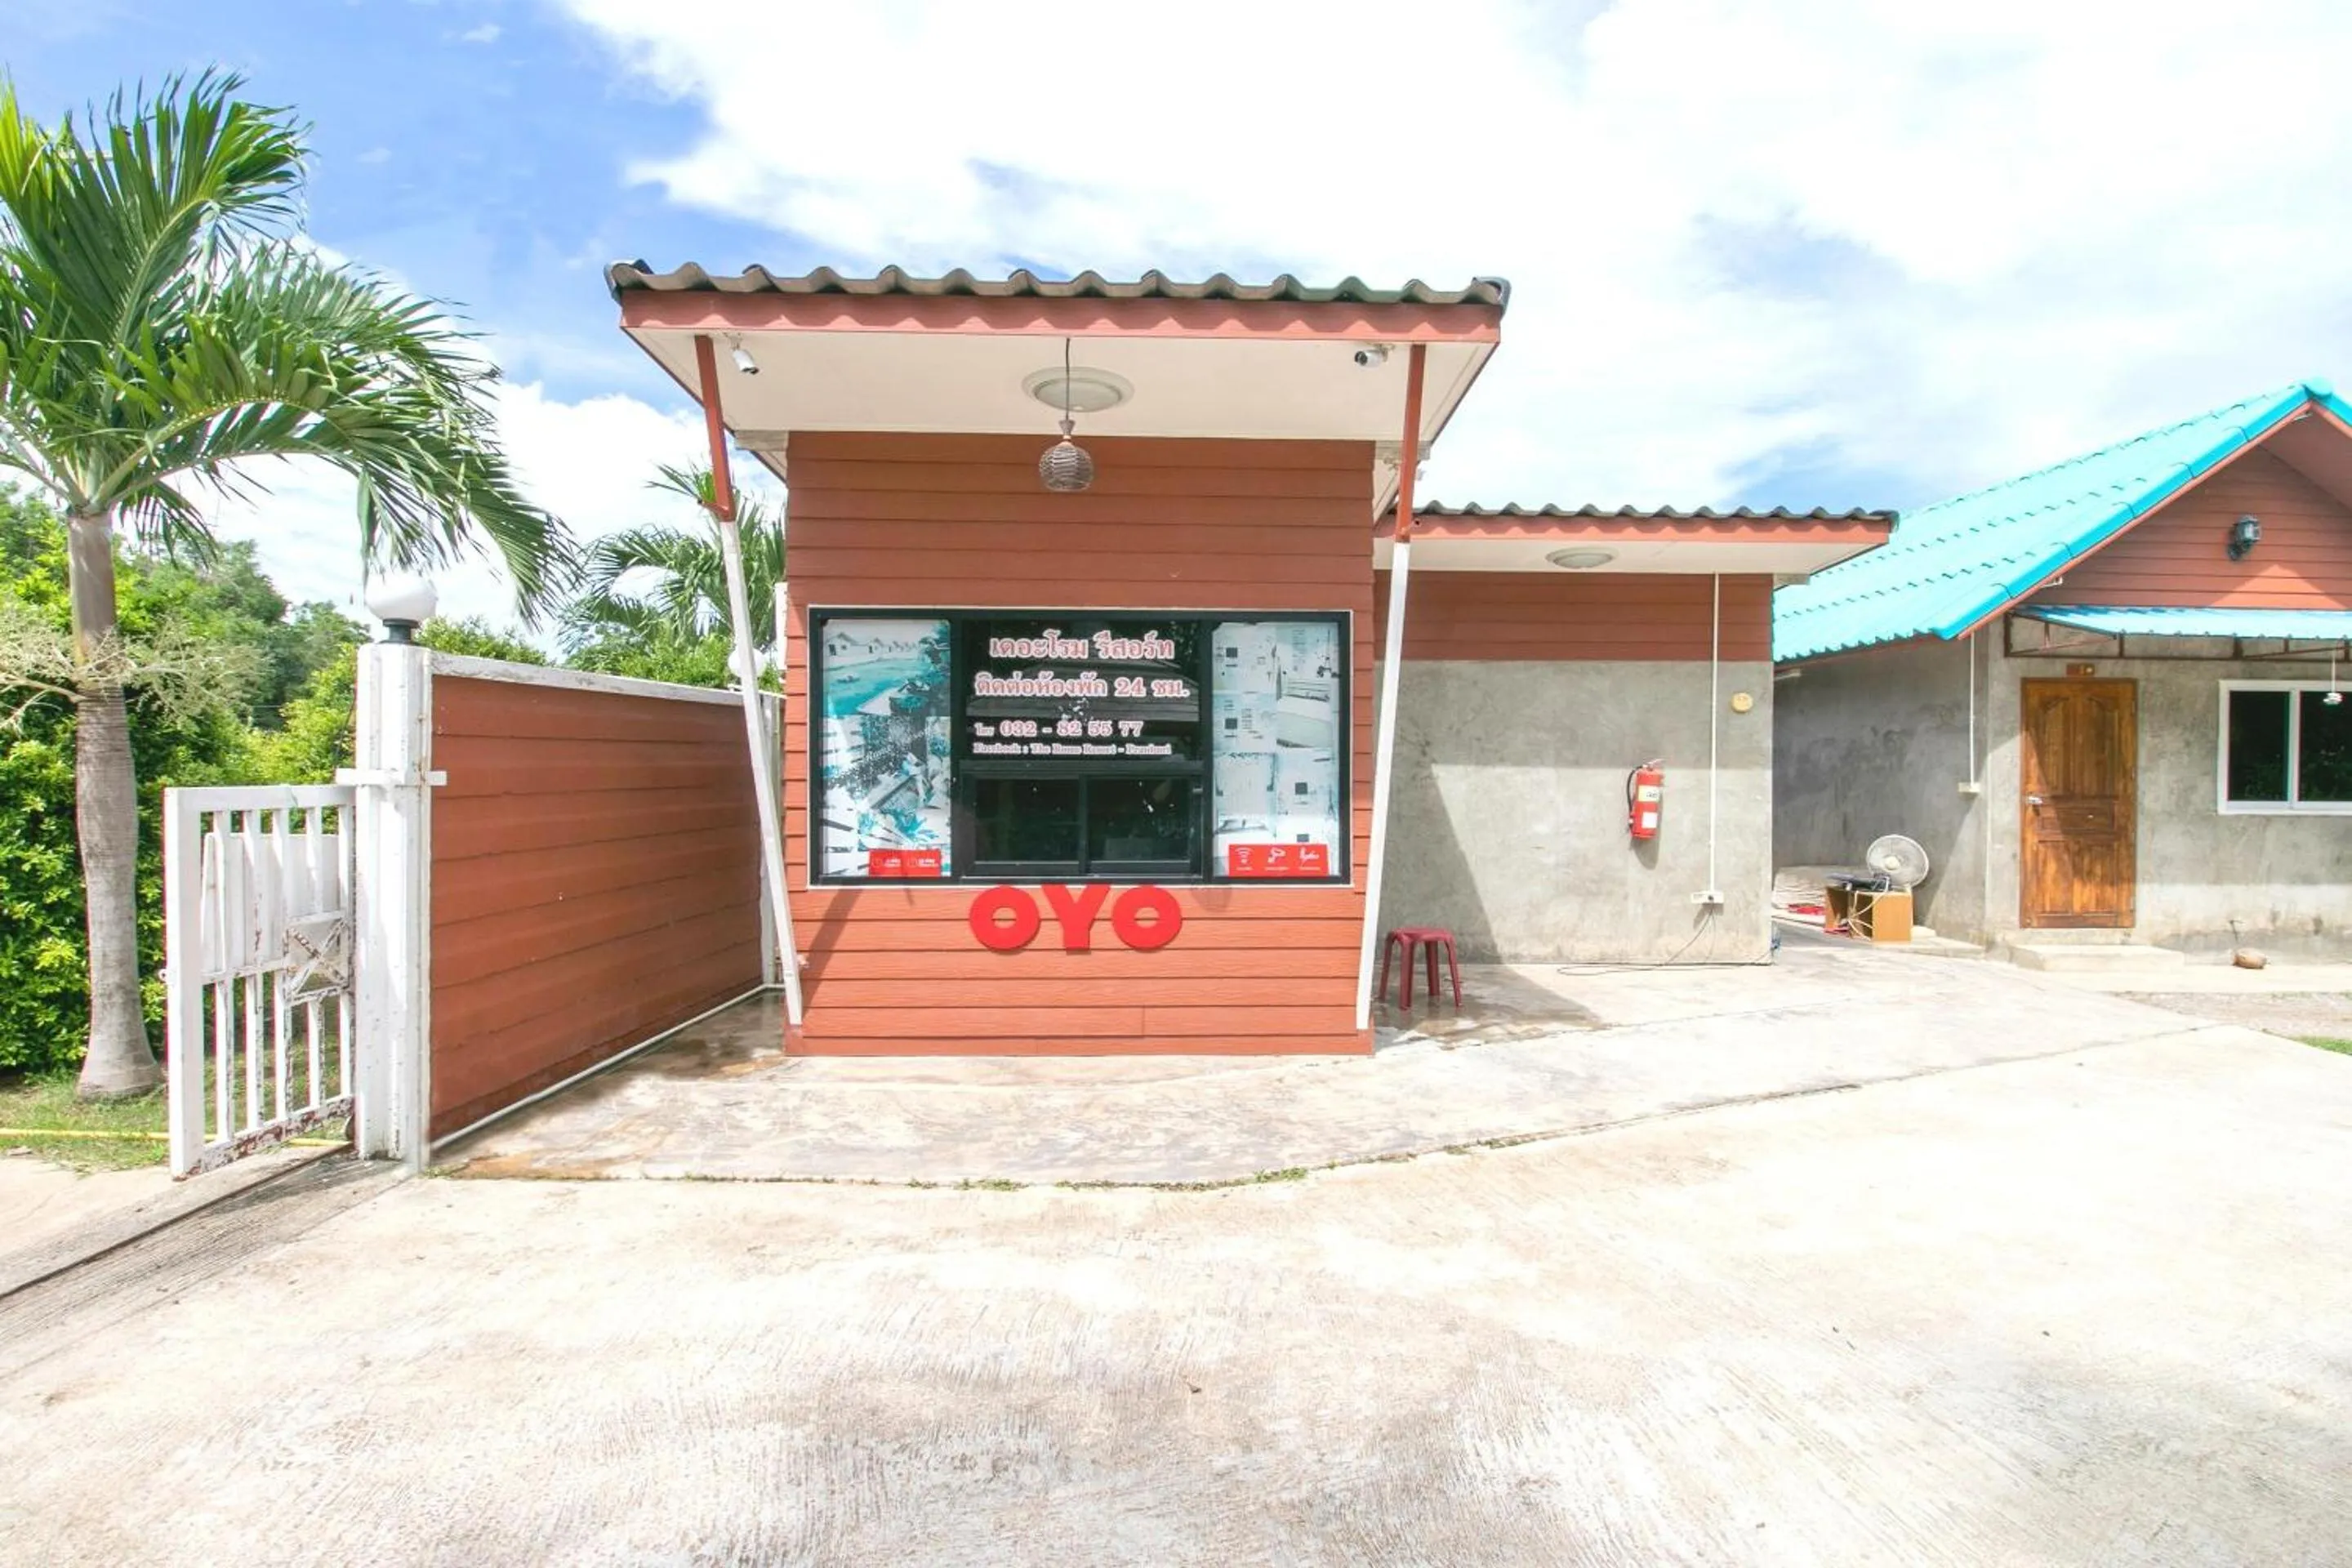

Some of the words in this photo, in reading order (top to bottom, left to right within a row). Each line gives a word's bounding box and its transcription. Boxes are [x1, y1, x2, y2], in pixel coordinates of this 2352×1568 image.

[990, 628, 1089, 658] เดอะโรม
[1093, 630, 1175, 659] รีสอร์ท
[975, 670, 1107, 697] ติดต่อห้องพัก
[1114, 676, 1147, 697] 24
[1000, 719, 1037, 737] 032
[1088, 720, 1112, 737] 55
[1118, 720, 1143, 737] 77
[969, 884, 1182, 951] OYO
